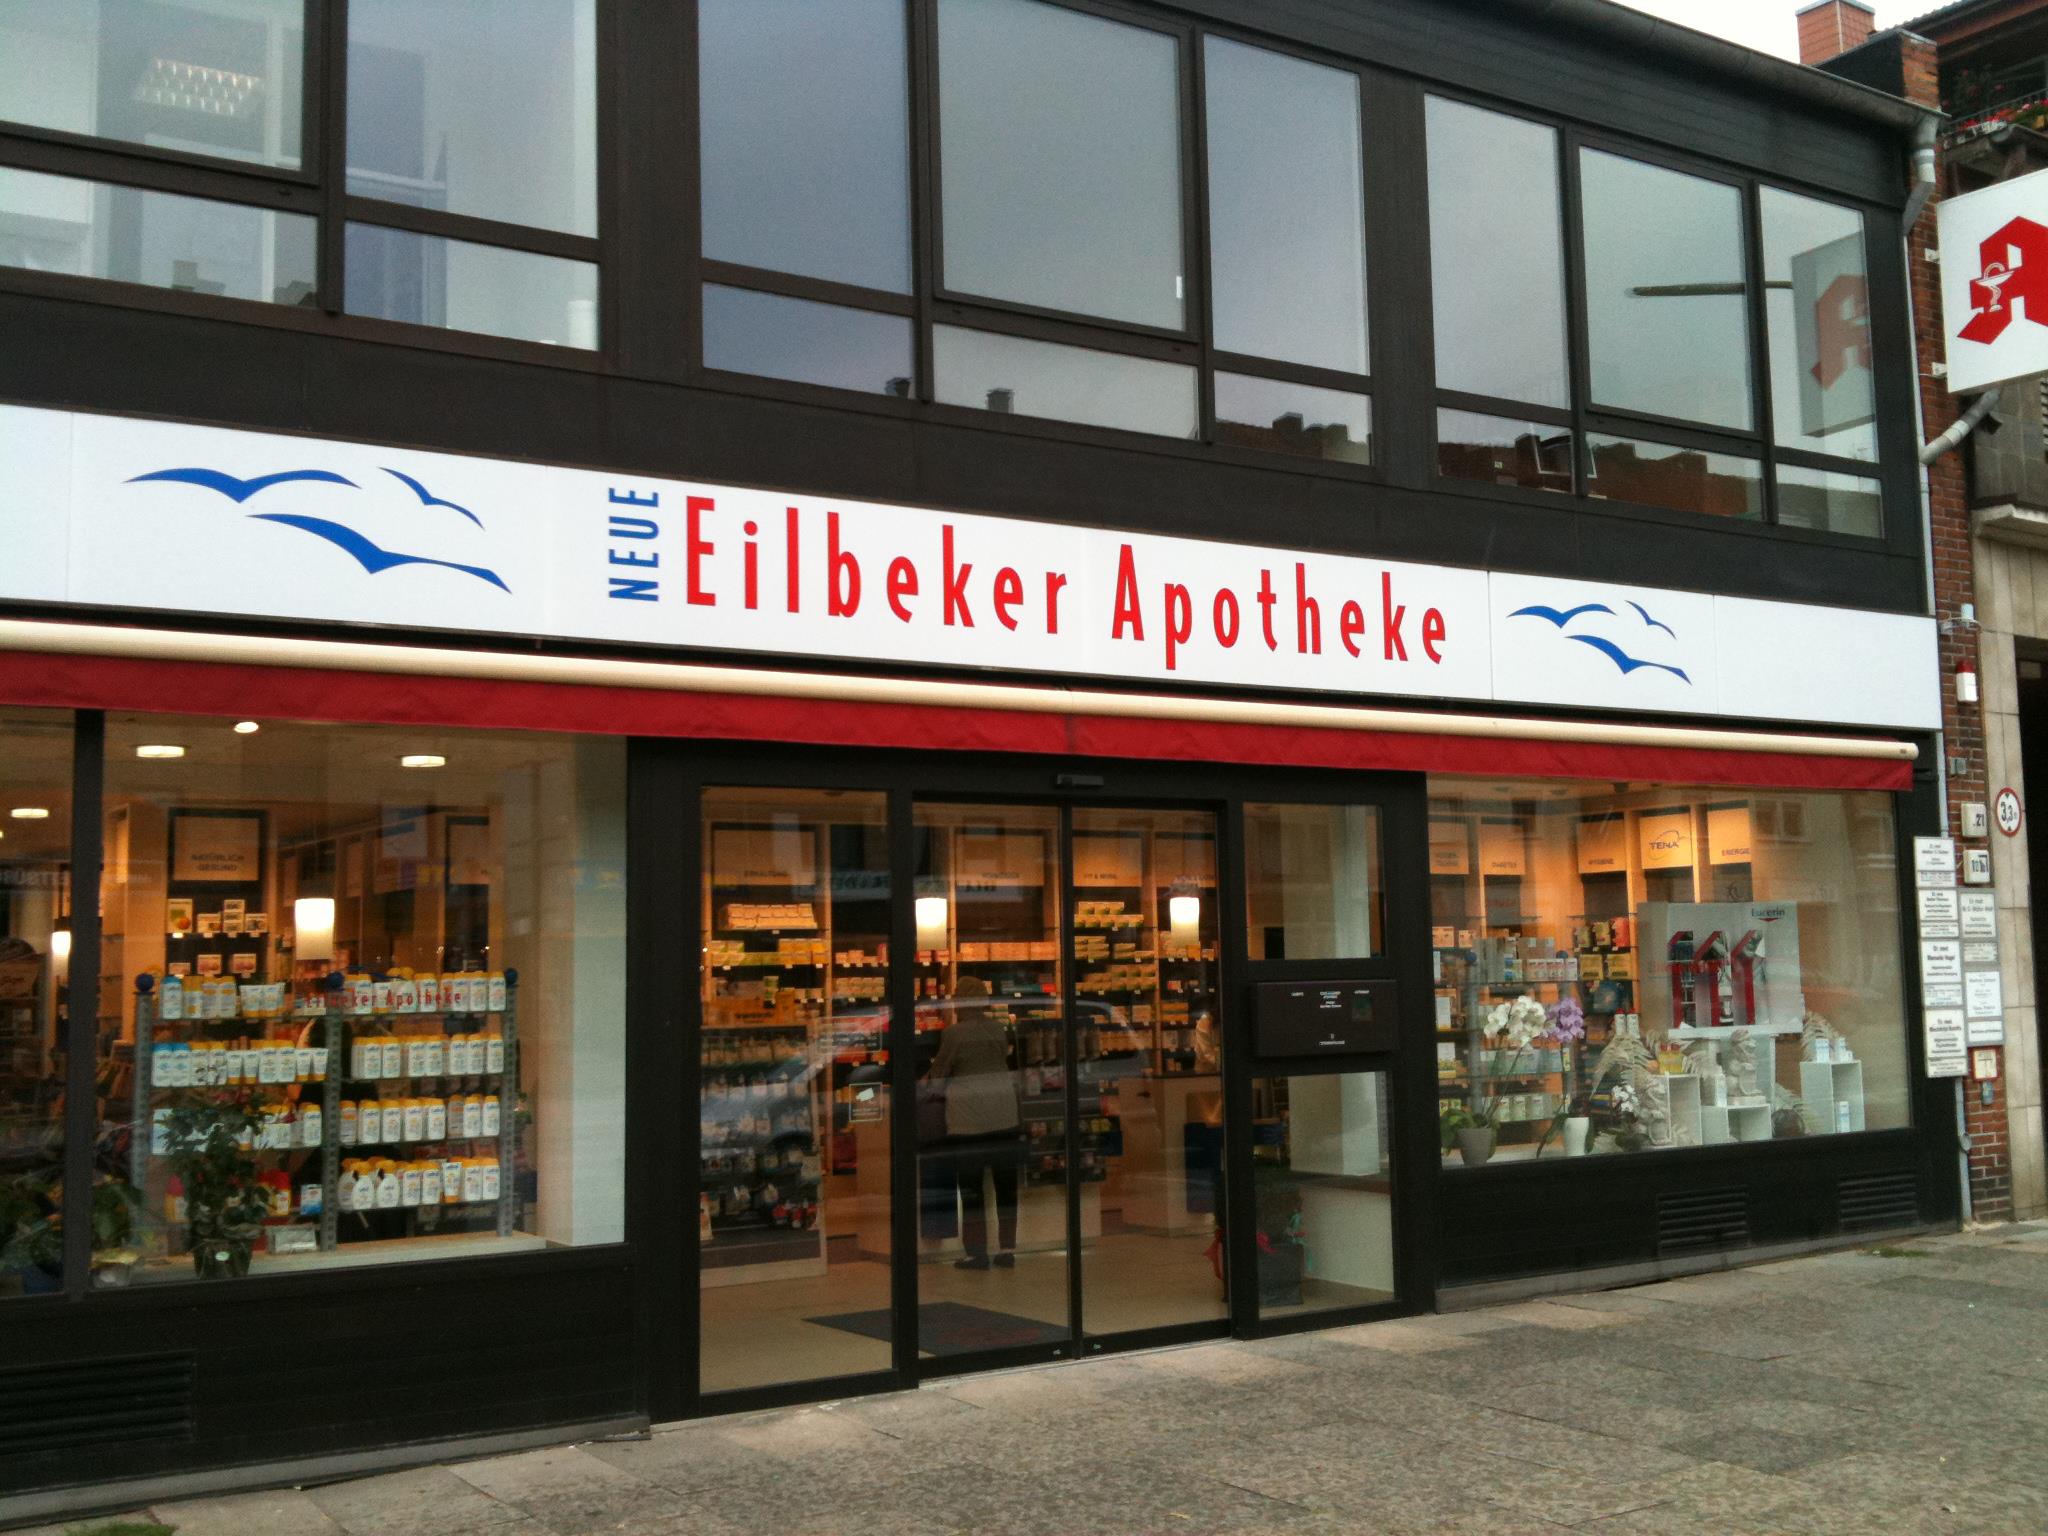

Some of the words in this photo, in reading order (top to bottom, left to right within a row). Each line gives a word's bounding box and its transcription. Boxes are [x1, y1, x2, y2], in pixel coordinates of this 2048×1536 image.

[609, 489, 659, 602] NEUE
[687, 496, 1067, 634] Eilbeker
[1112, 544, 1447, 671] Apotheke
